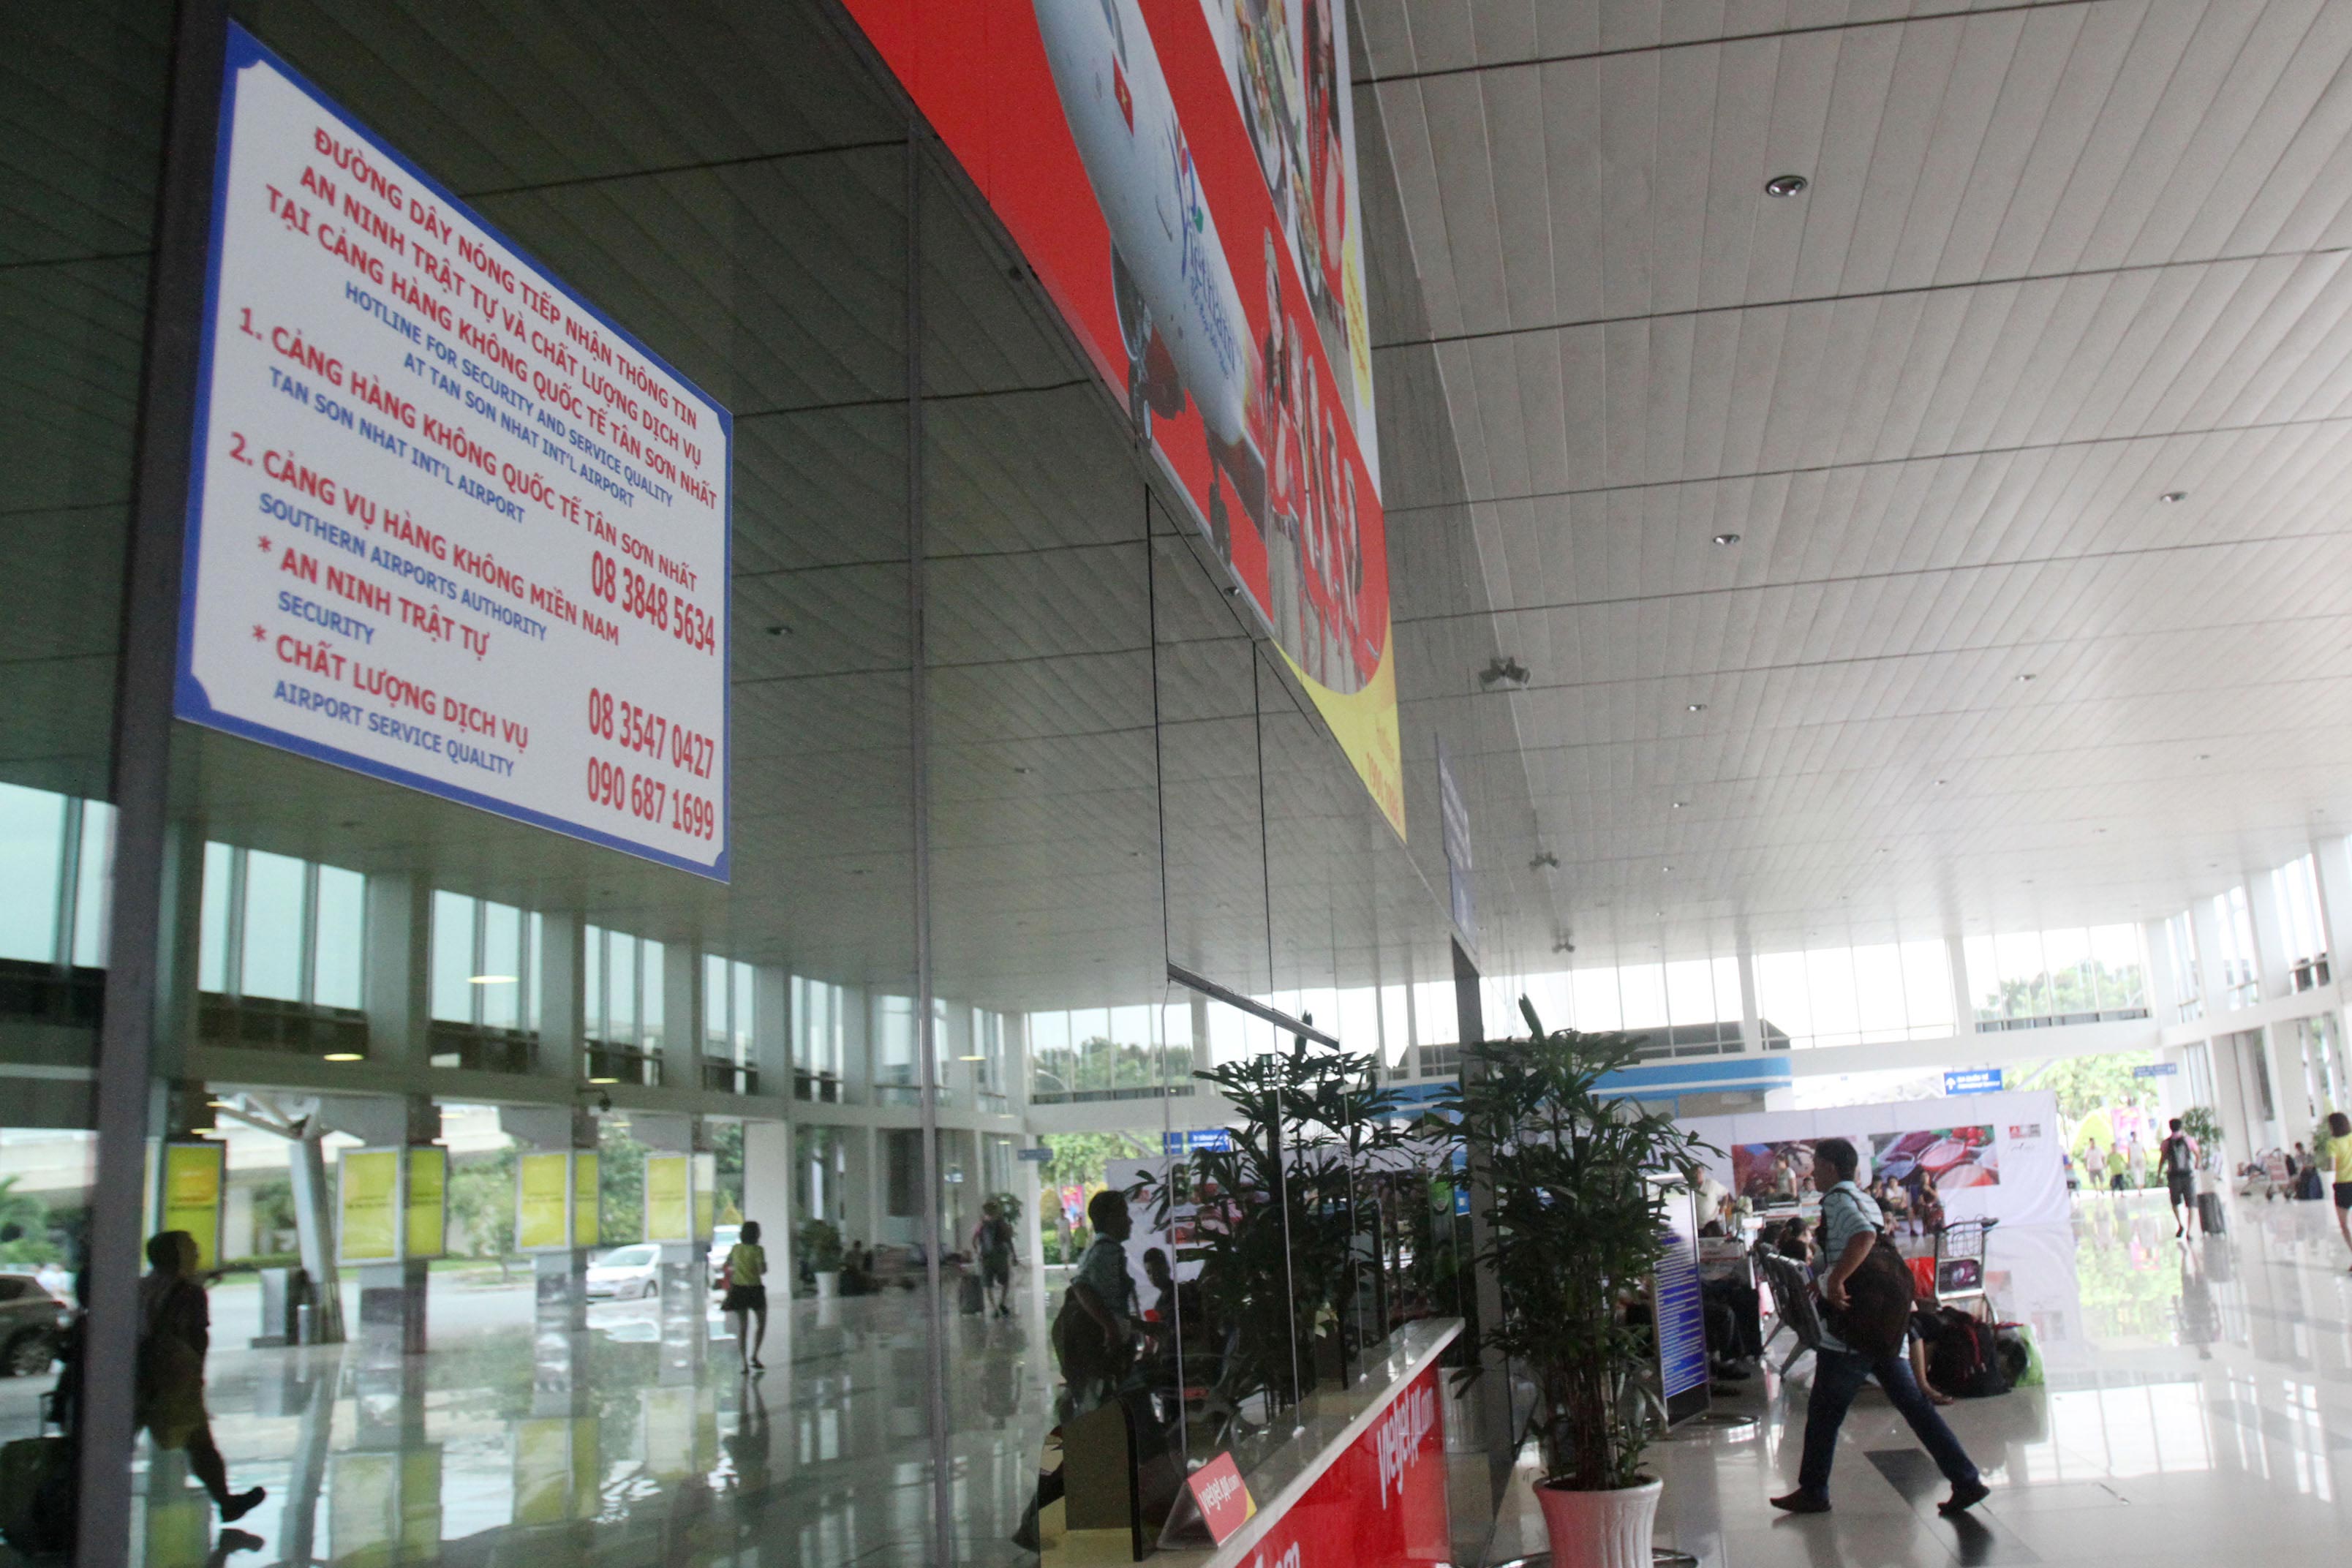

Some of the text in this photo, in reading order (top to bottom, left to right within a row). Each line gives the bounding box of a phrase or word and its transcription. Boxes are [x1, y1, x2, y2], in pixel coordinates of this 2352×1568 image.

[266, 184, 717, 509] TẠI CẢNG HÀNG KHÔNG QUỐC TẾ TÂN SƠN NHẤT
[300, 166, 701, 470] AN NINH TRẬT TỰ VÀ CHẤT LƯỢNG DỊCH VỤ
[314, 127, 697, 429] ĐƯỜNG DÂY NÓNG TIẾP NHẬN THÔNG TIN
[240, 307, 698, 589] 1. CẢNG HÀNG KHÔNG QUỐC TẾ TÂN SƠN NHẤT
[268, 366, 309, 405] TAN
[312, 391, 354, 430] SON
[357, 415, 409, 457] NHAT
[456, 473, 525, 524] AIRPORT
[344, 279, 673, 505] HOTLINE FOR SECURITY AND SERVICE QUALITY
[402, 350, 427, 377] AT
[428, 364, 461, 400] TAN
[464, 388, 497, 422] SON
[500, 411, 539, 448] NHAT
[578, 463, 635, 506] AIRPORT
[229, 431, 619, 644] 2. CẢNG VỤ HÀNG KHÔNG MIỀN NAM
[258, 491, 547, 641] SOUTHERN AIRPORTS AUTHORITY
[280, 546, 490, 660] AN NINH TRẬT TỰ
[591, 550, 715, 656] 08 3848 5634
[276, 633, 528, 753] CHẤT LƯỢNG DỊCH VỤ
[277, 589, 374, 645] SECURITY
[273, 679, 514, 777] AIRPORT SERVICE QUALITY
[587, 755, 715, 840] 090 687 1699
[588, 687, 715, 779] 08 3547 0427
